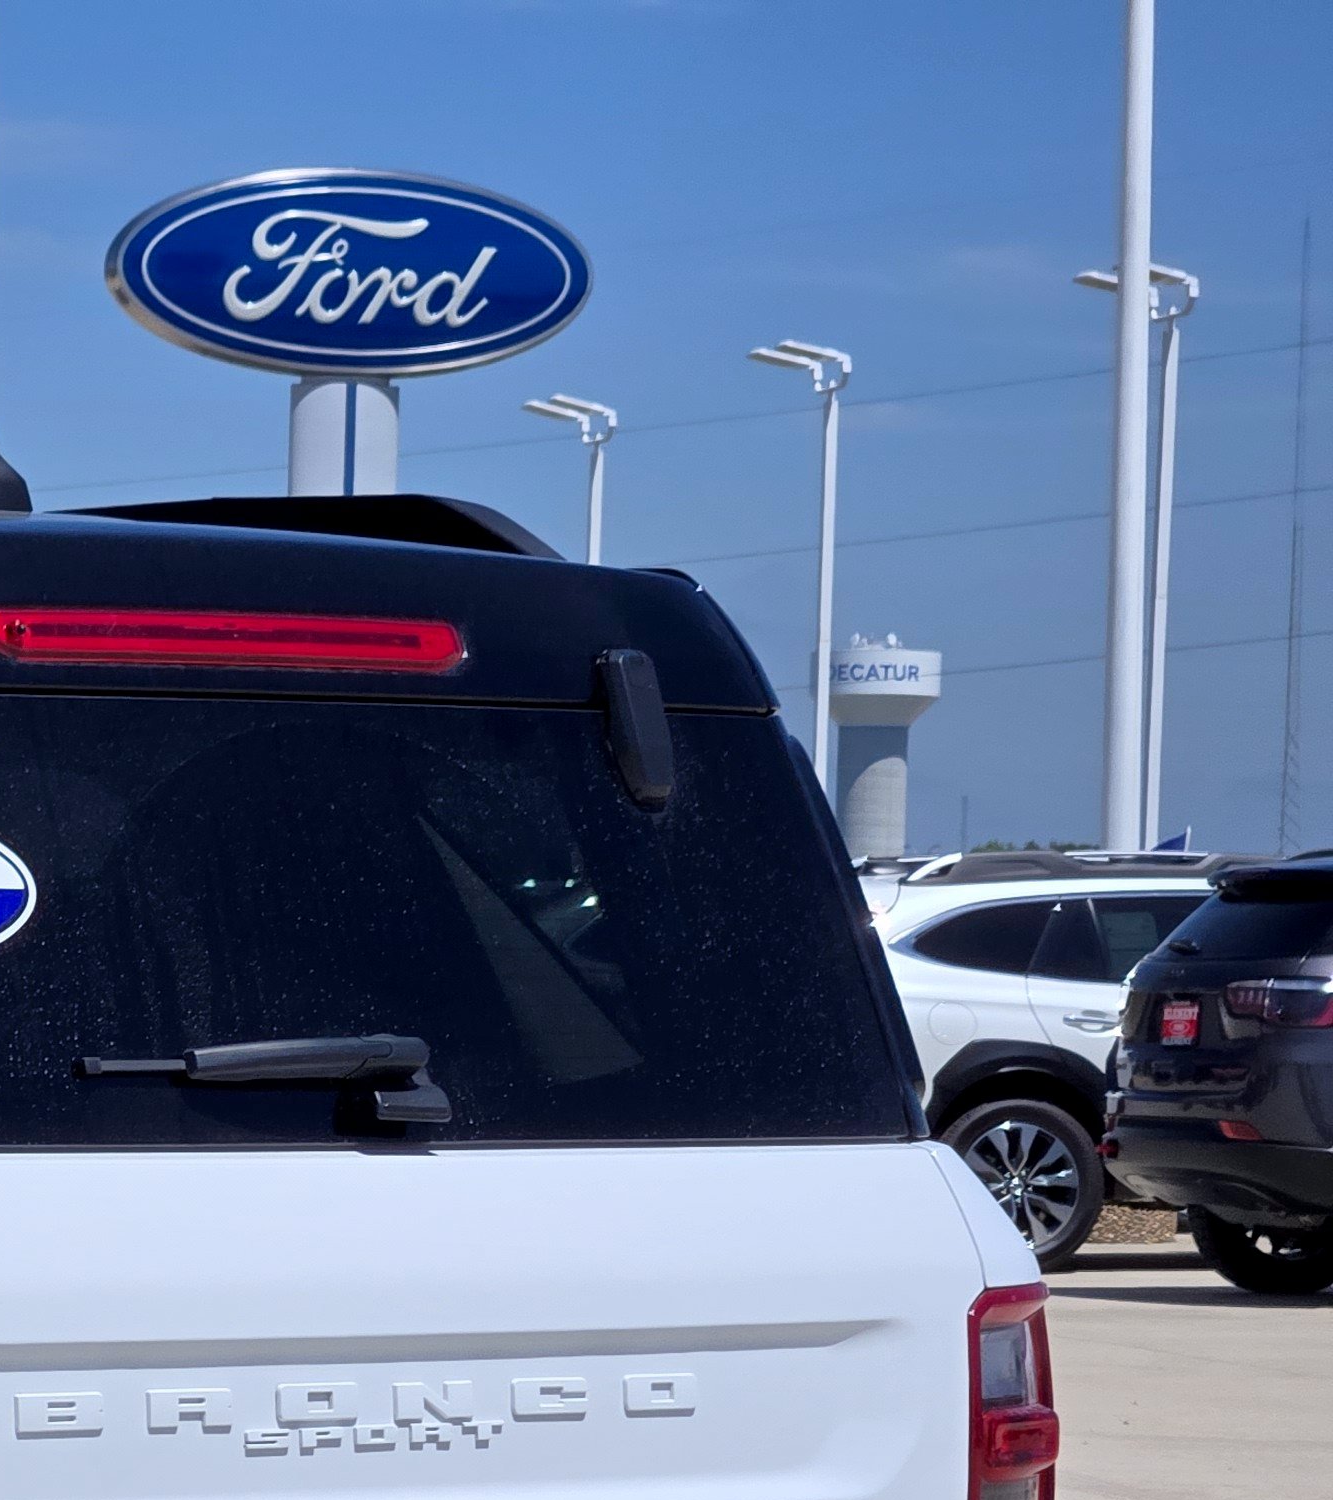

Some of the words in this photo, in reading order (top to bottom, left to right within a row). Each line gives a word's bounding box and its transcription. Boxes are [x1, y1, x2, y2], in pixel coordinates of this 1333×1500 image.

[222, 208, 498, 327] Ford
[12, 1372, 697, 1439] BRONCO
[243, 1418, 505, 1457] SPORT
